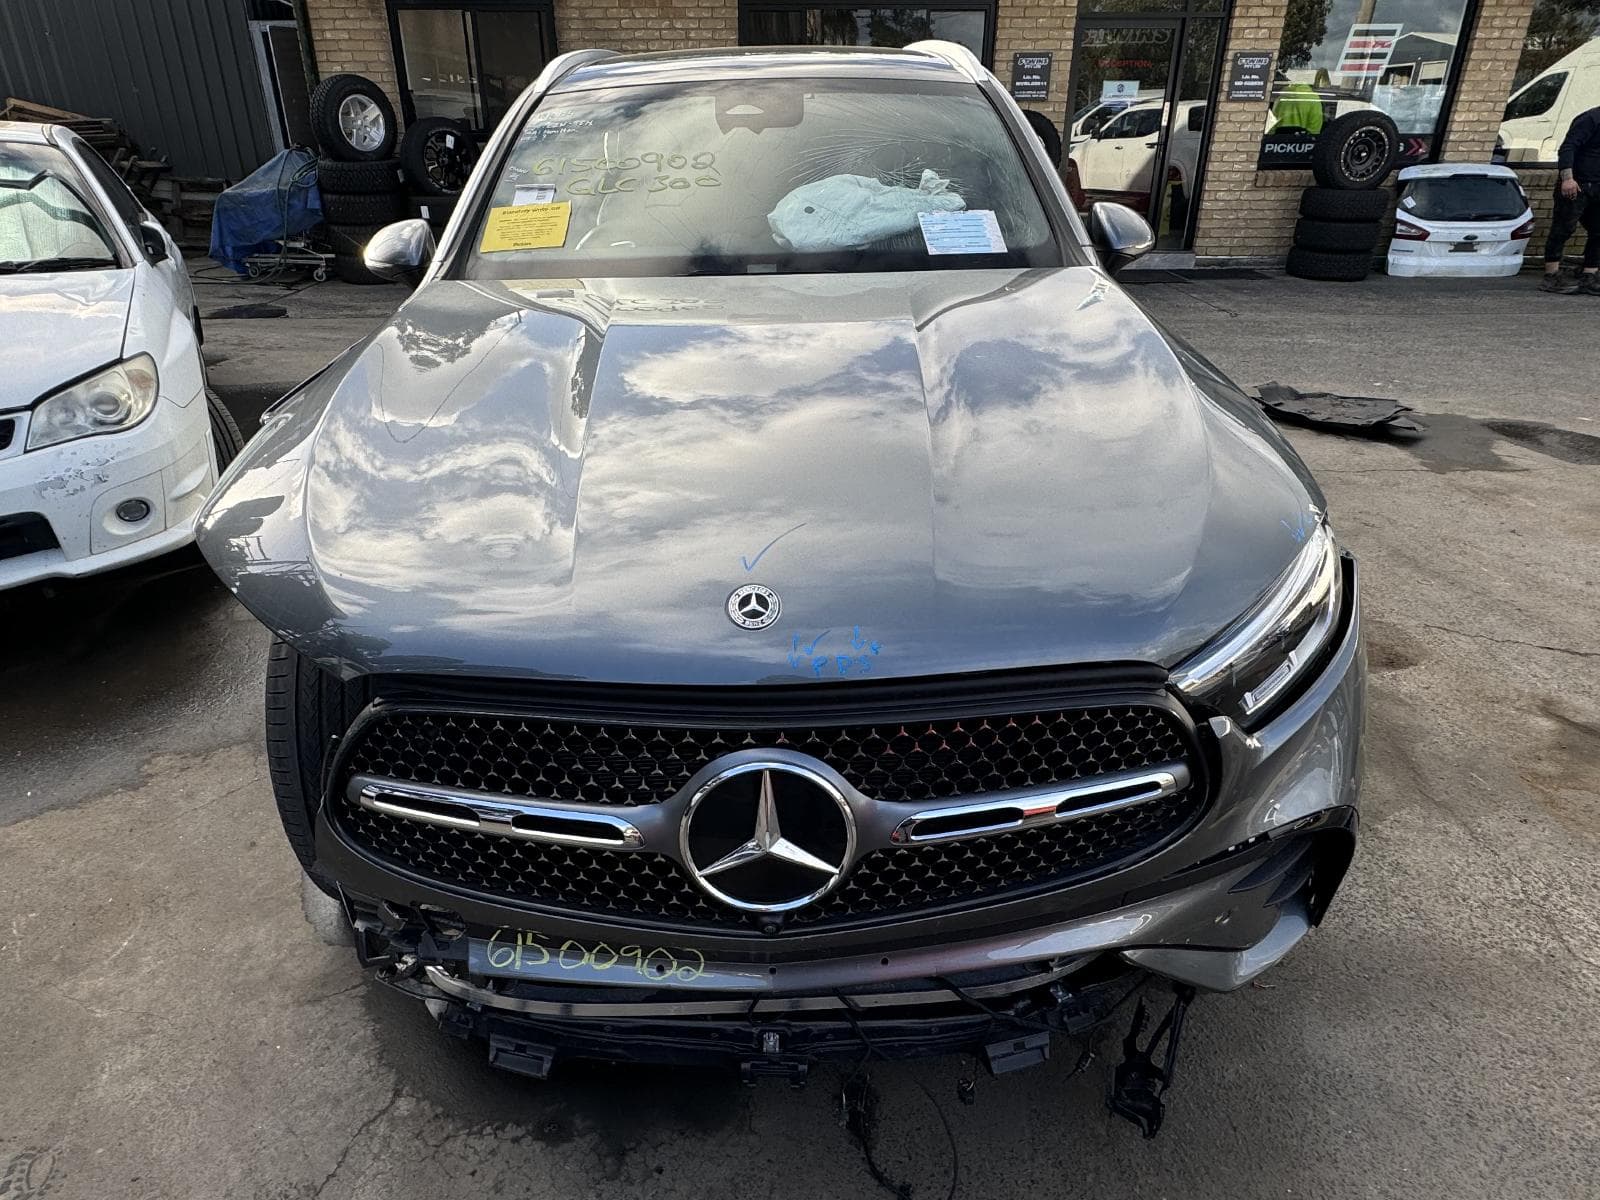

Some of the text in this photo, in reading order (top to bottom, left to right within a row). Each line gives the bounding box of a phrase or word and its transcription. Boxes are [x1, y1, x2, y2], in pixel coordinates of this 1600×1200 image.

[1264, 143, 1314, 153] PICKUP
[534, 152, 721, 176] 61500902
[566, 178, 637, 196] GLC
[648, 175, 721, 193] 300
[487, 925, 714, 981] 61500902
